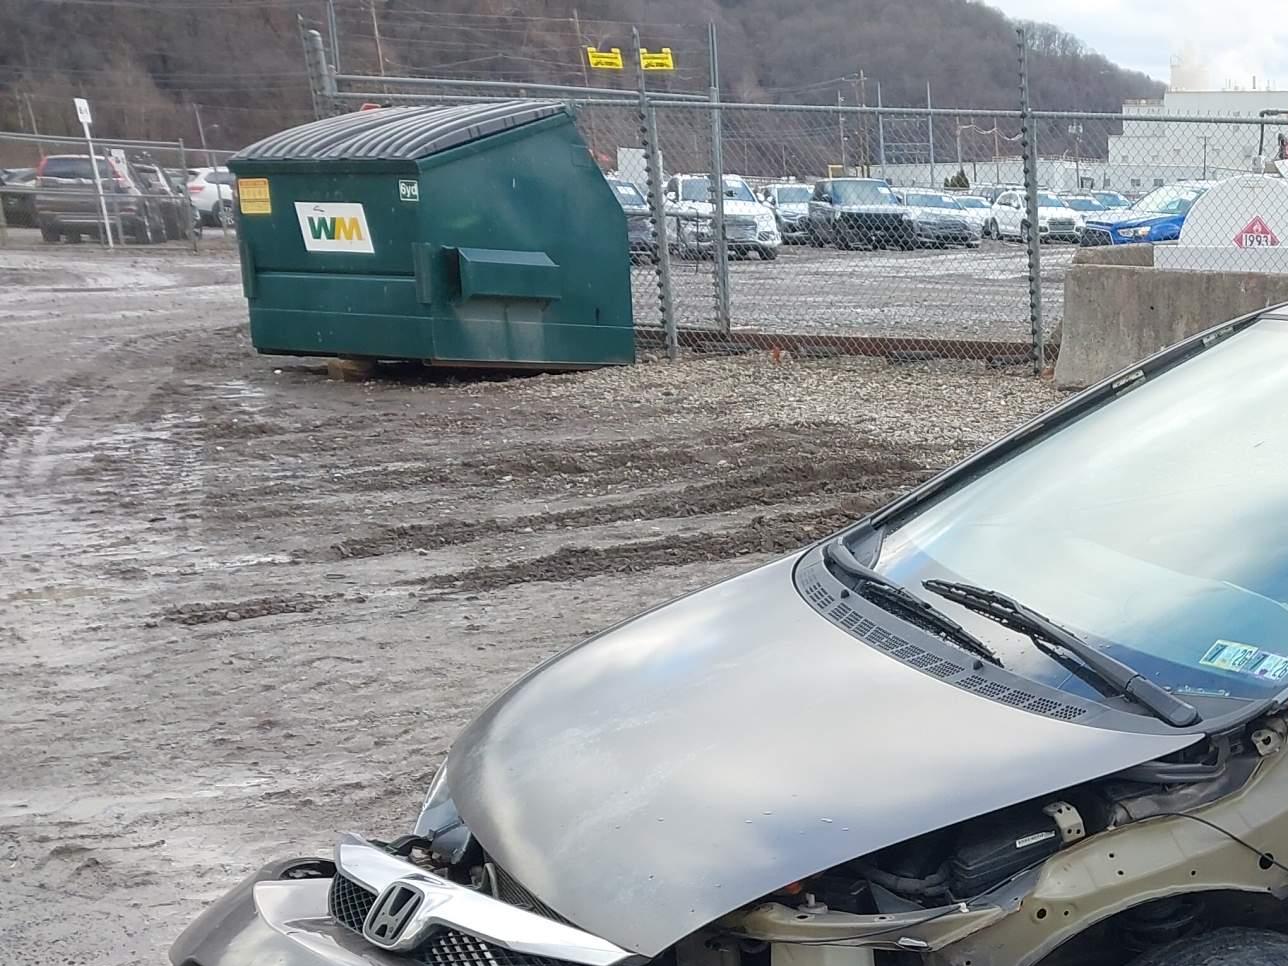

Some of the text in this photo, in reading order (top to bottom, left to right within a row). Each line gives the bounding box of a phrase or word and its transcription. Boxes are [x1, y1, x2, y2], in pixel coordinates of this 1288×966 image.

[400, 182, 418, 198] 6yd
[307, 216, 363, 240] WM
[1244, 234, 1269, 247] 1993
